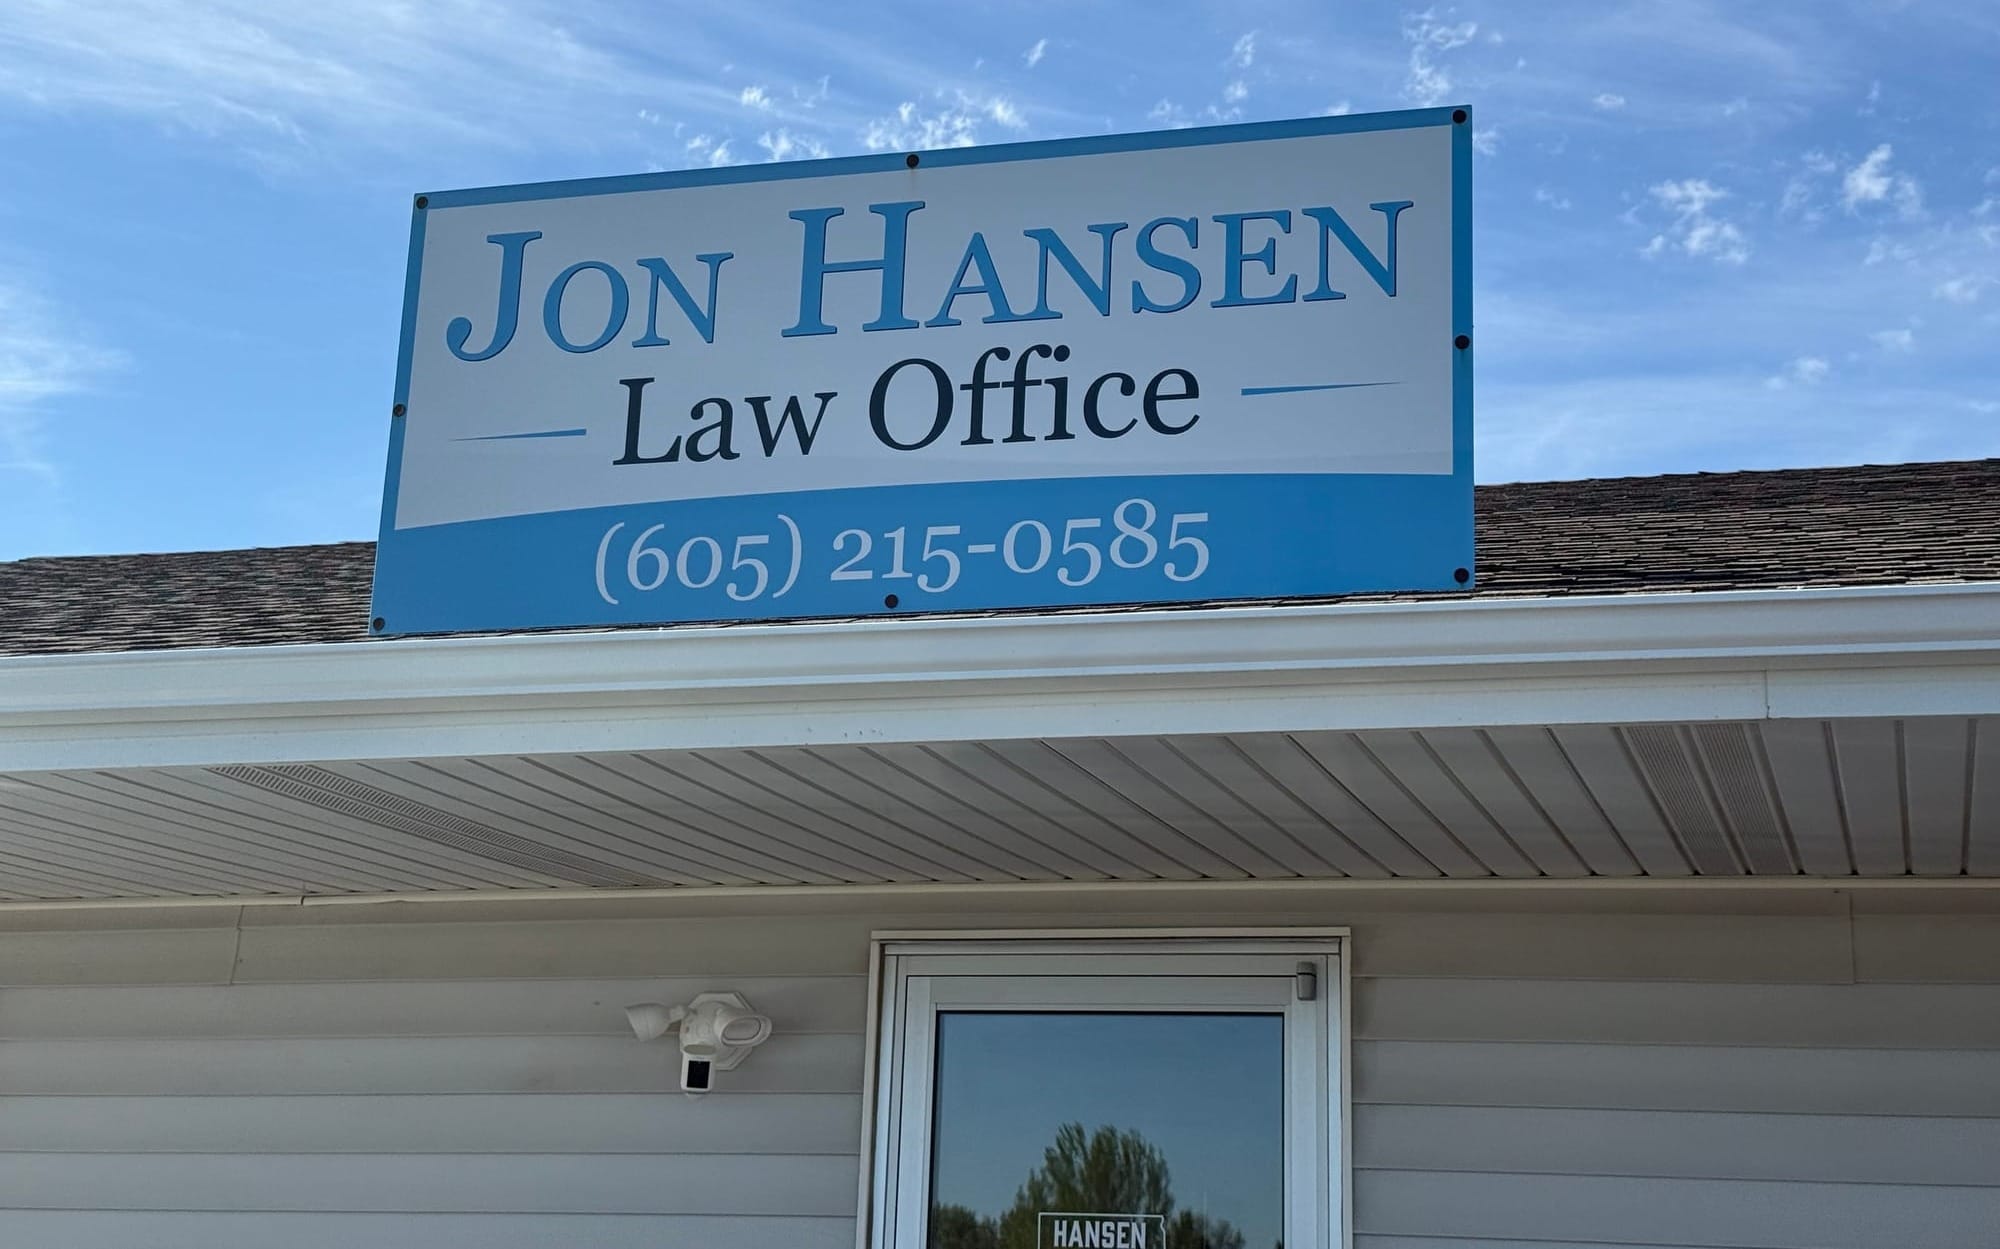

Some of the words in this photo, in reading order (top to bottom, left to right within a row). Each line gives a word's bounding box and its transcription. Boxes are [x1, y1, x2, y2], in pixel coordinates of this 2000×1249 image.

[781, 200, 1414, 338] HANSEN
[612, 377, 838, 466] Law
[869, 344, 1200, 451] Office
[596, 514, 801, 605] (605)
[830, 498, 1210, 594] 215-0585
[1053, 1219, 1147, 1249] HANSEN
